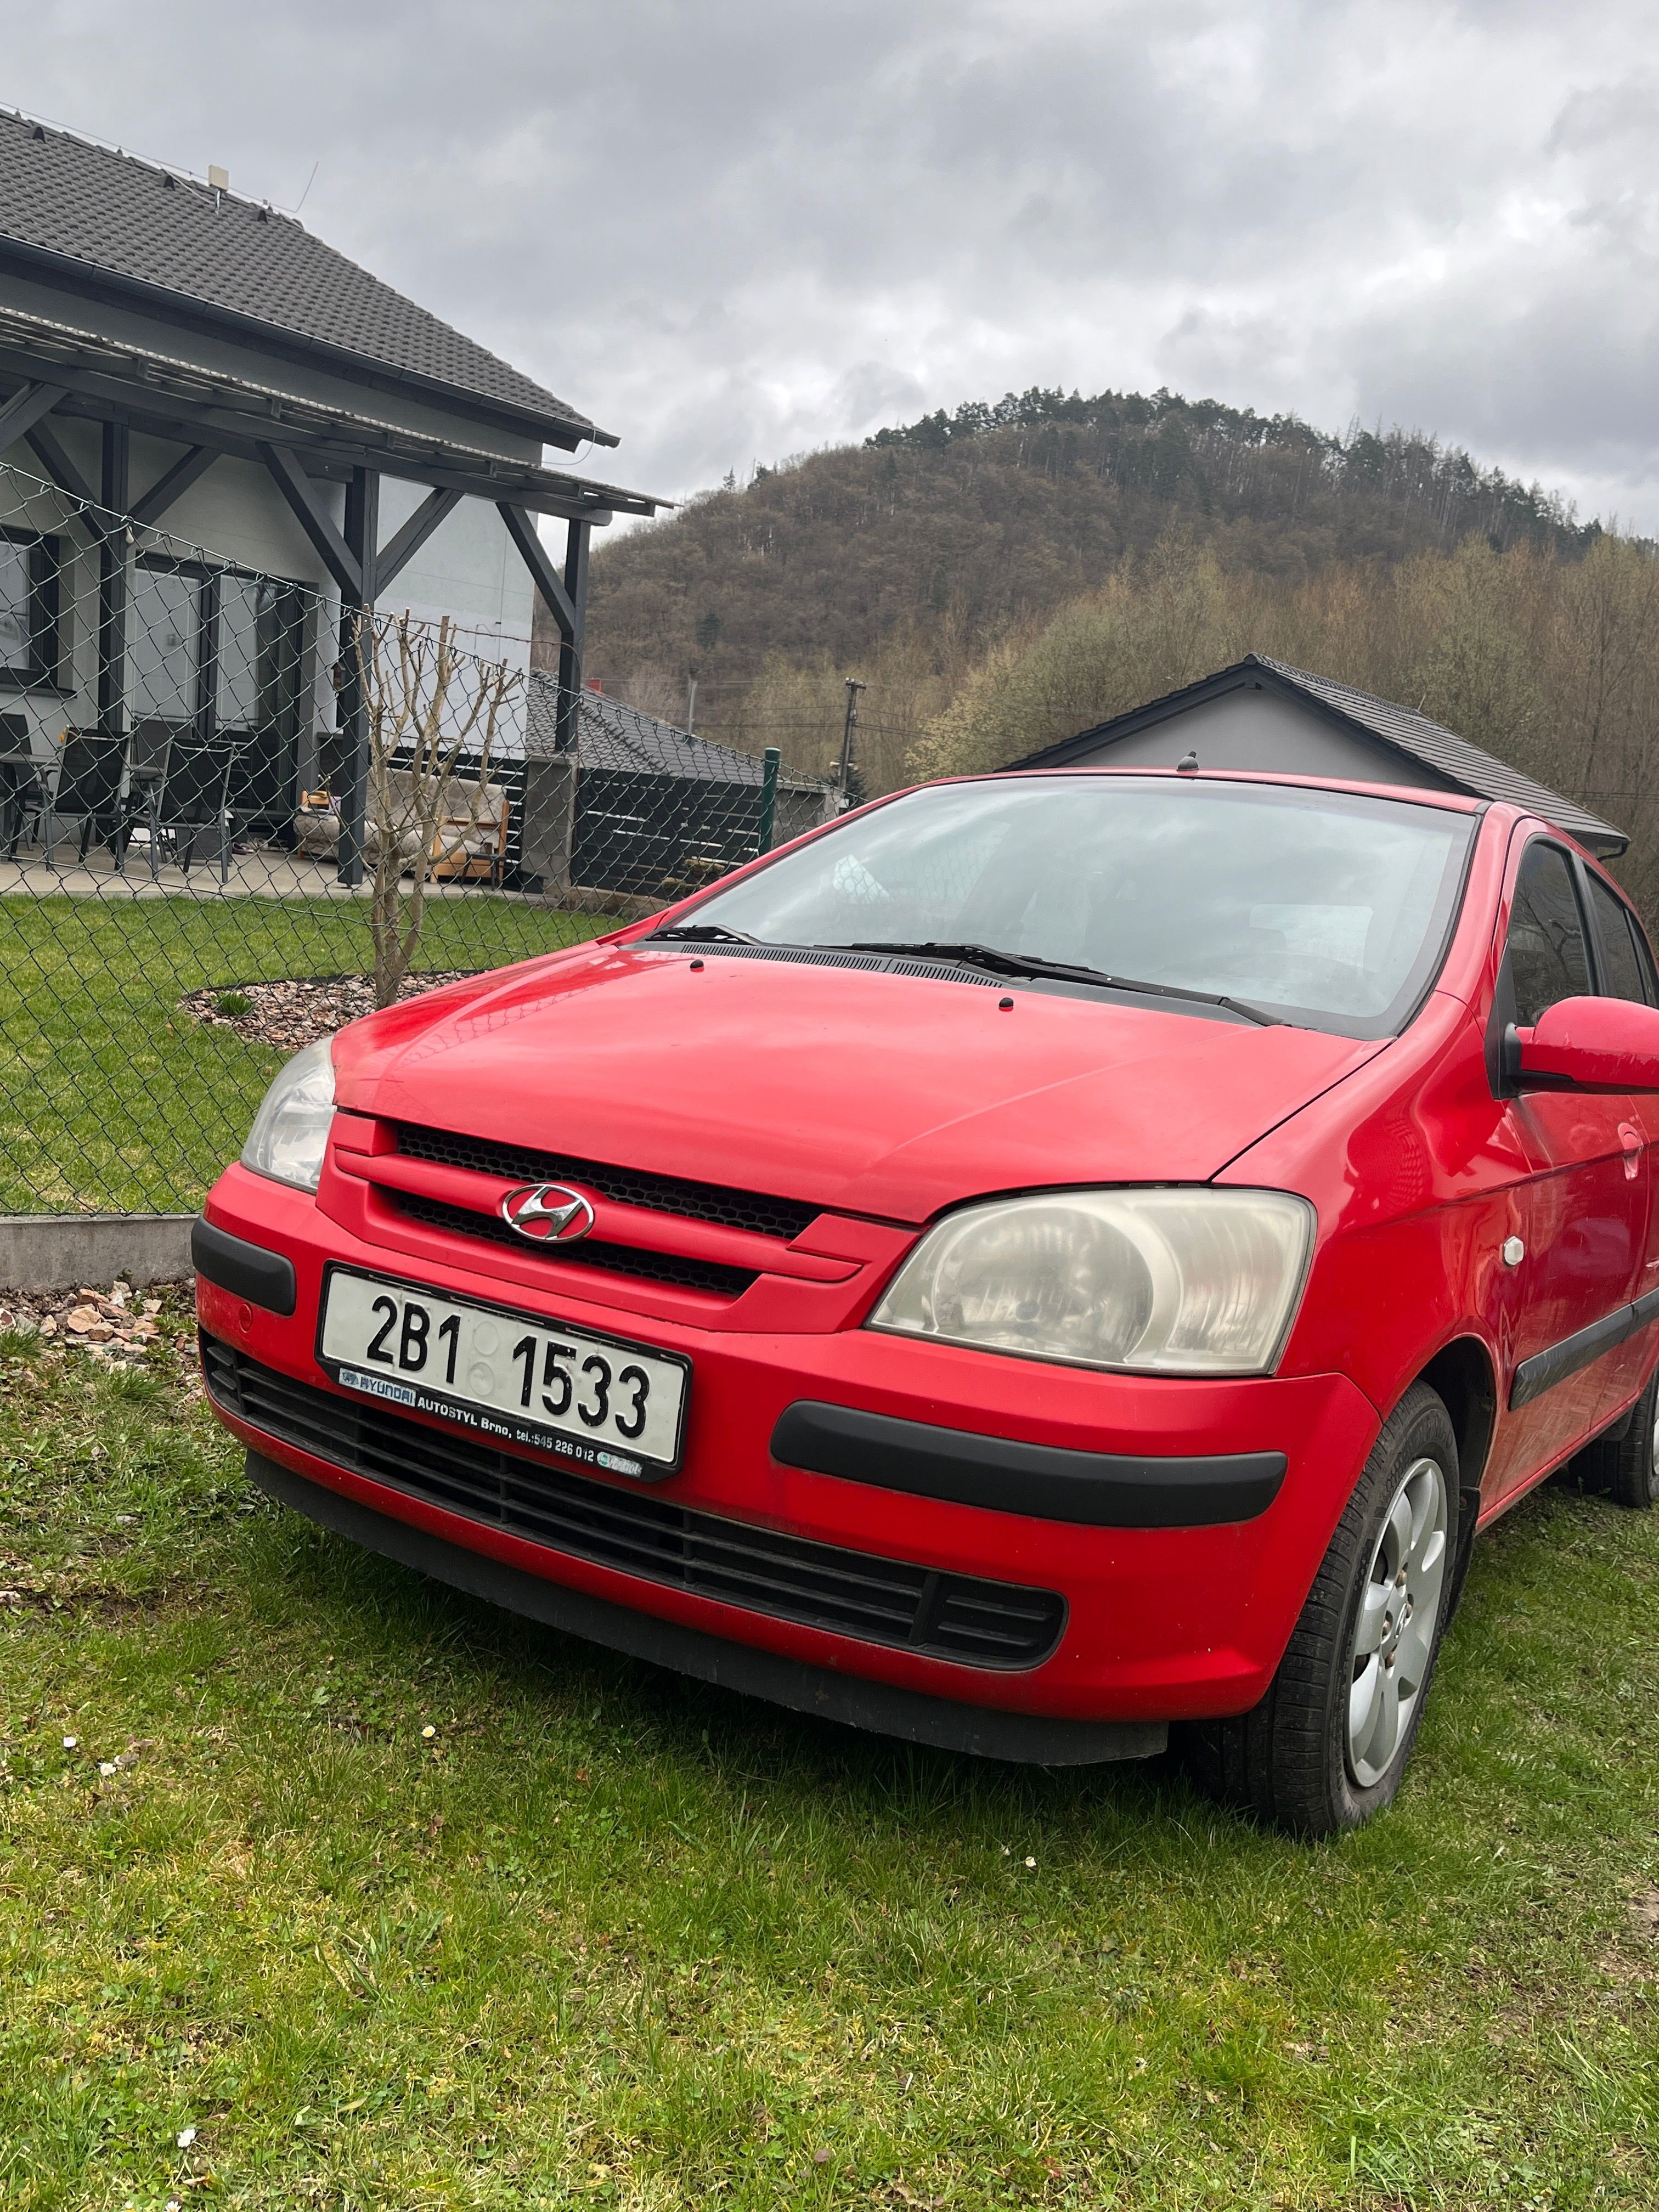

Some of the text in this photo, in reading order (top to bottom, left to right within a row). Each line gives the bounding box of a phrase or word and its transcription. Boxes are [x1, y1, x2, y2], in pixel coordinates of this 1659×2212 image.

[360, 1375, 413, 1404] HYUNDAI
[417, 1396, 478, 1426] AUTOSTYL
[481, 1417, 512, 1440] Brno,
[555, 1439, 573, 1454] 226
[366, 1294, 650, 1438] 2B1 1533
